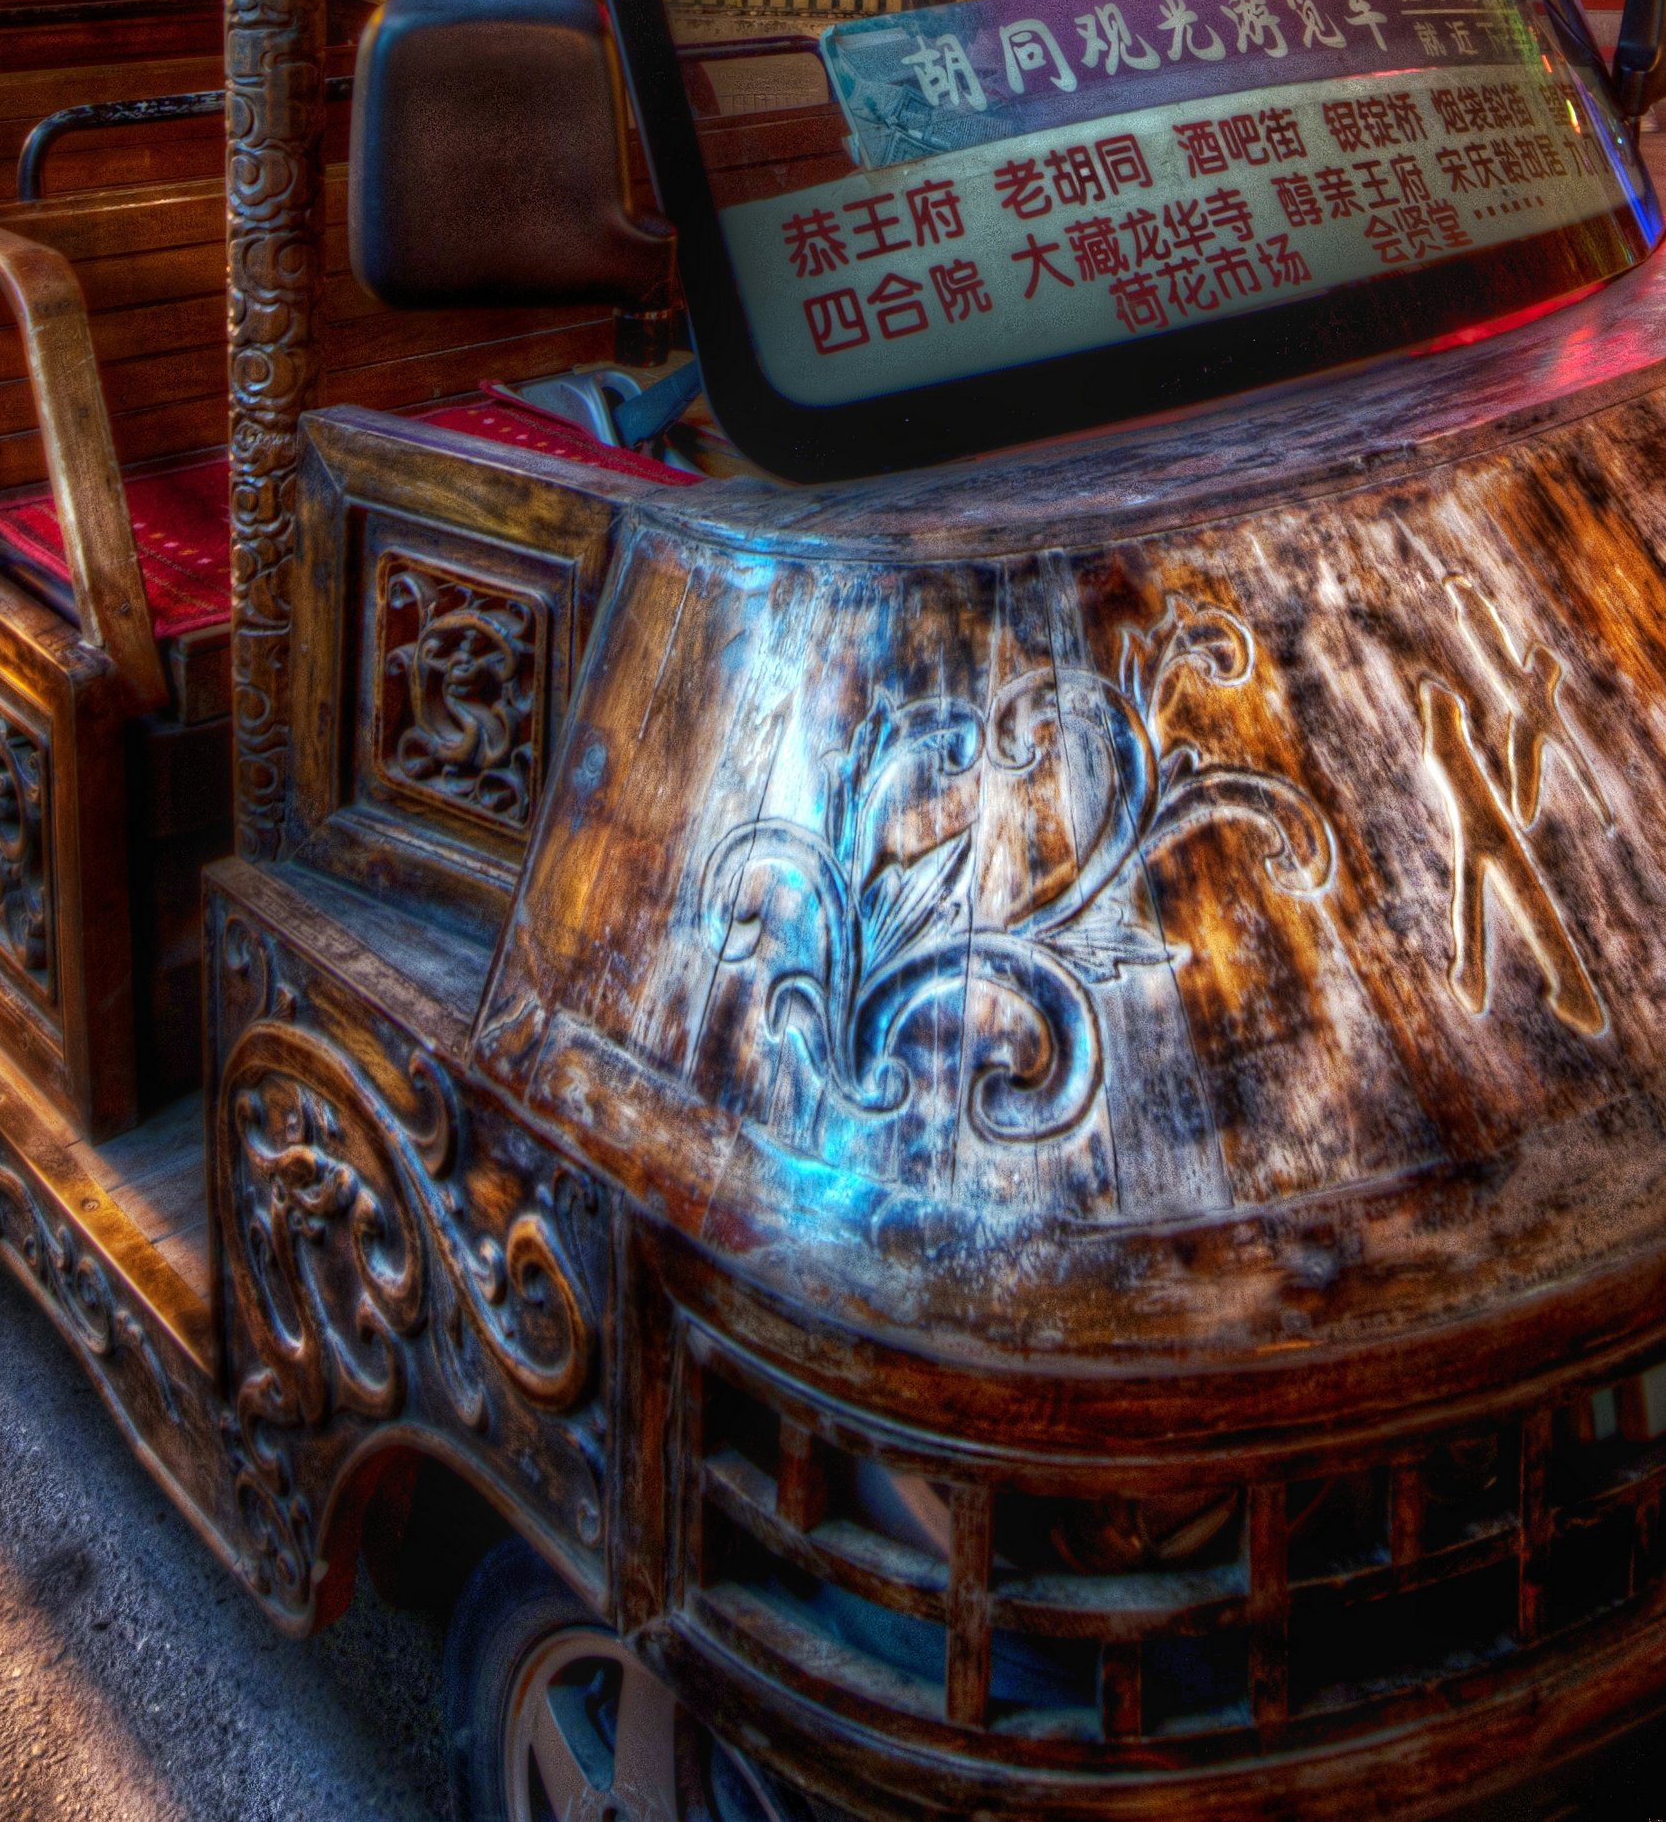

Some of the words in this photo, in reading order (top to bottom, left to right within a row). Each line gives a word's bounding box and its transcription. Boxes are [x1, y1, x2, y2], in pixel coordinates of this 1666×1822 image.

[781, 179, 967, 279] 恭王府
[993, 132, 1155, 221] 老胡同
[1172, 106, 1305, 179] 酒吧街
[1322, 91, 1432, 154] 银锭桥
[802, 258, 994, 357] 四合院
[1011, 186, 1255, 301] 大藏龙华寺
[1276, 152, 1432, 232] 醇亲王府
[1435, 134, 1570, 195] 宋庆龄故居
[1108, 234, 1313, 335] 荷花市场
